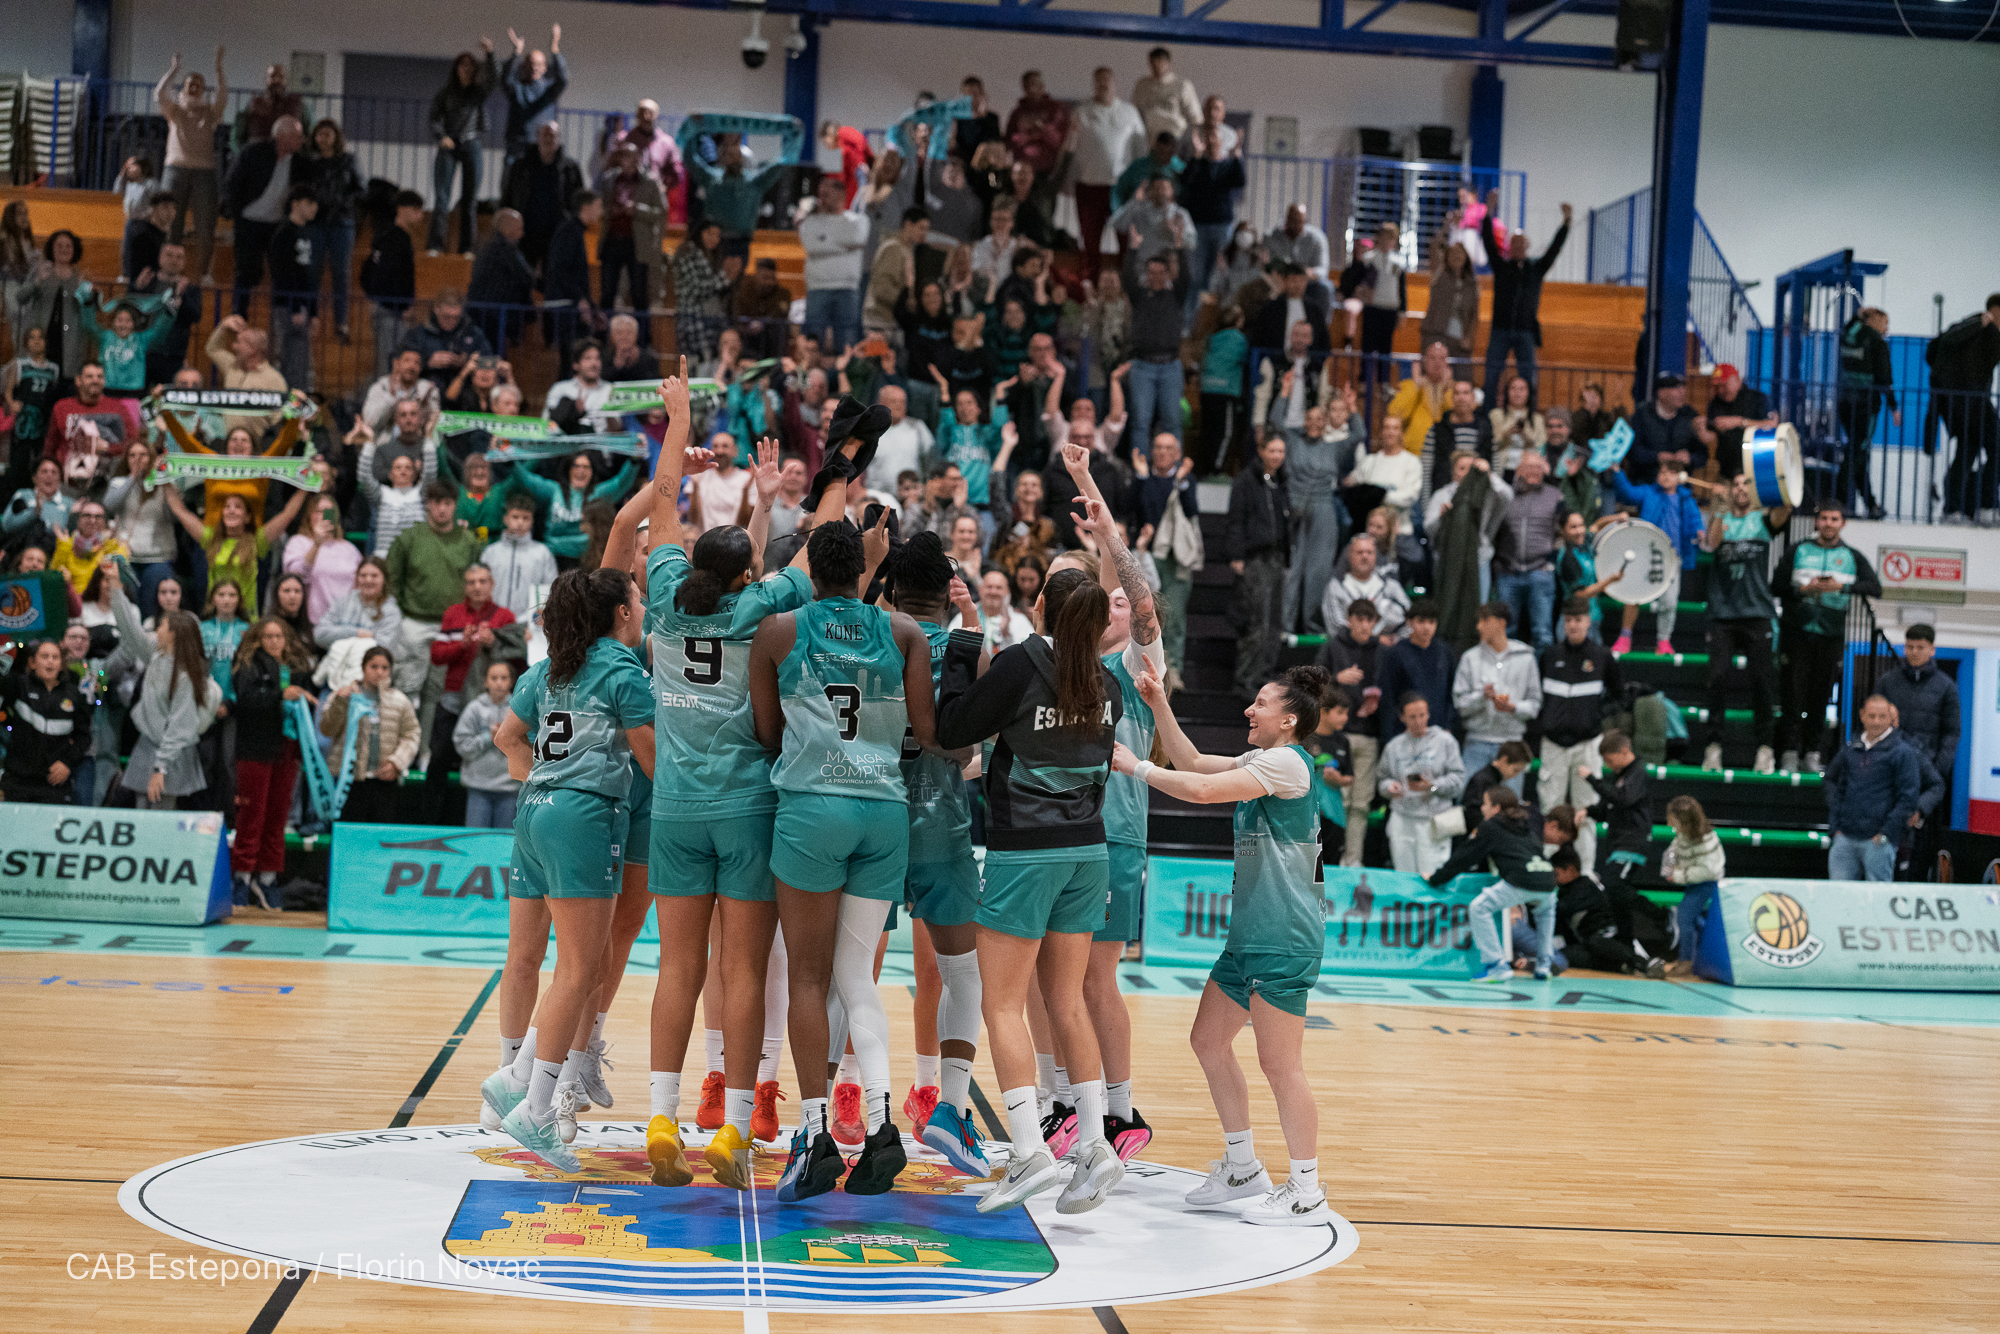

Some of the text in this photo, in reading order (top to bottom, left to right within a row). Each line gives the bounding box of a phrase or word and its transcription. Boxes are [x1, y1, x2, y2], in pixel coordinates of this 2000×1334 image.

[824, 619, 863, 642] KONÉ
[682, 636, 724, 687] 9
[823, 683, 862, 743] 3
[820, 763, 889, 779] COMPITE
[53, 818, 136, 847] CAB
[1888, 895, 1960, 922] CAB
[1380, 902, 1473, 951] doce
